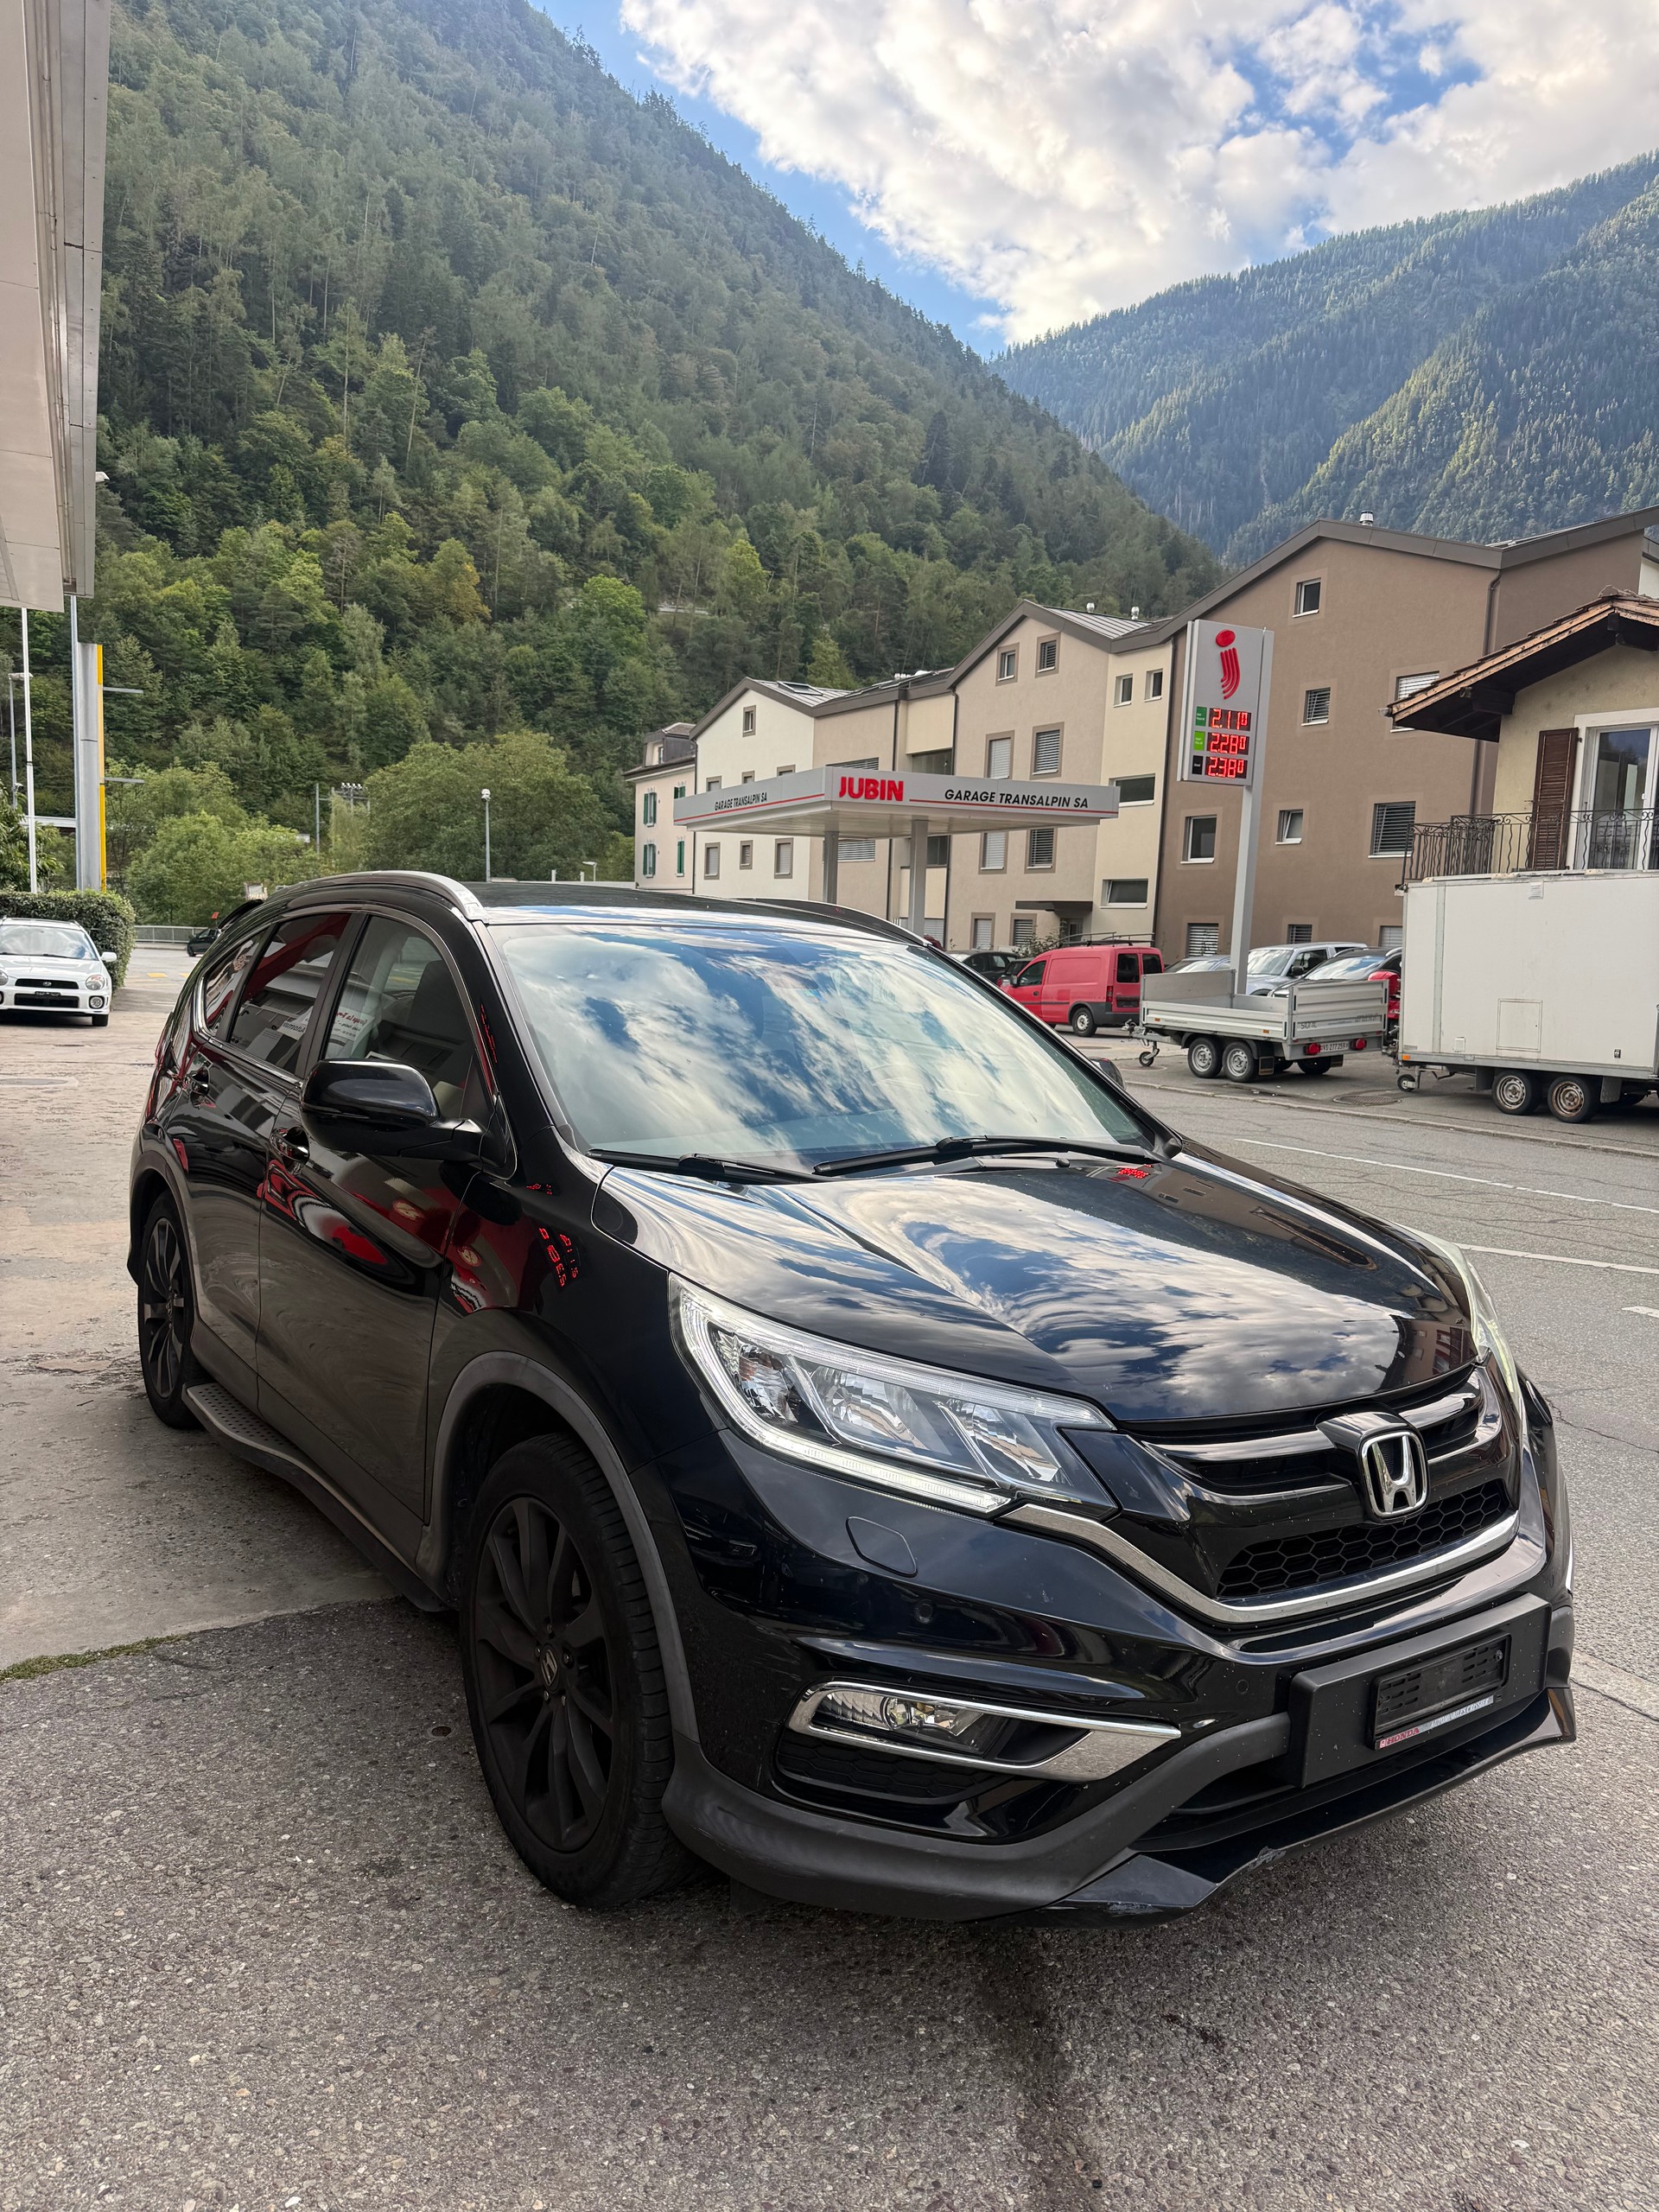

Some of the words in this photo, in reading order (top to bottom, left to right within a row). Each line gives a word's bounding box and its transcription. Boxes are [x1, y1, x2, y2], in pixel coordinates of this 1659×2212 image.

[838, 776, 904, 802] JUBIN
[715, 798, 733, 810] GARAGE
[734, 792, 760, 808] TRANSALPIN
[760, 791, 767, 802] SA
[944, 789, 996, 803] GARAGE
[999, 792, 1071, 808] TRANSALPIN
[1073, 798, 1089, 809] SA
[1386, 1727, 1420, 1744] HONDA
